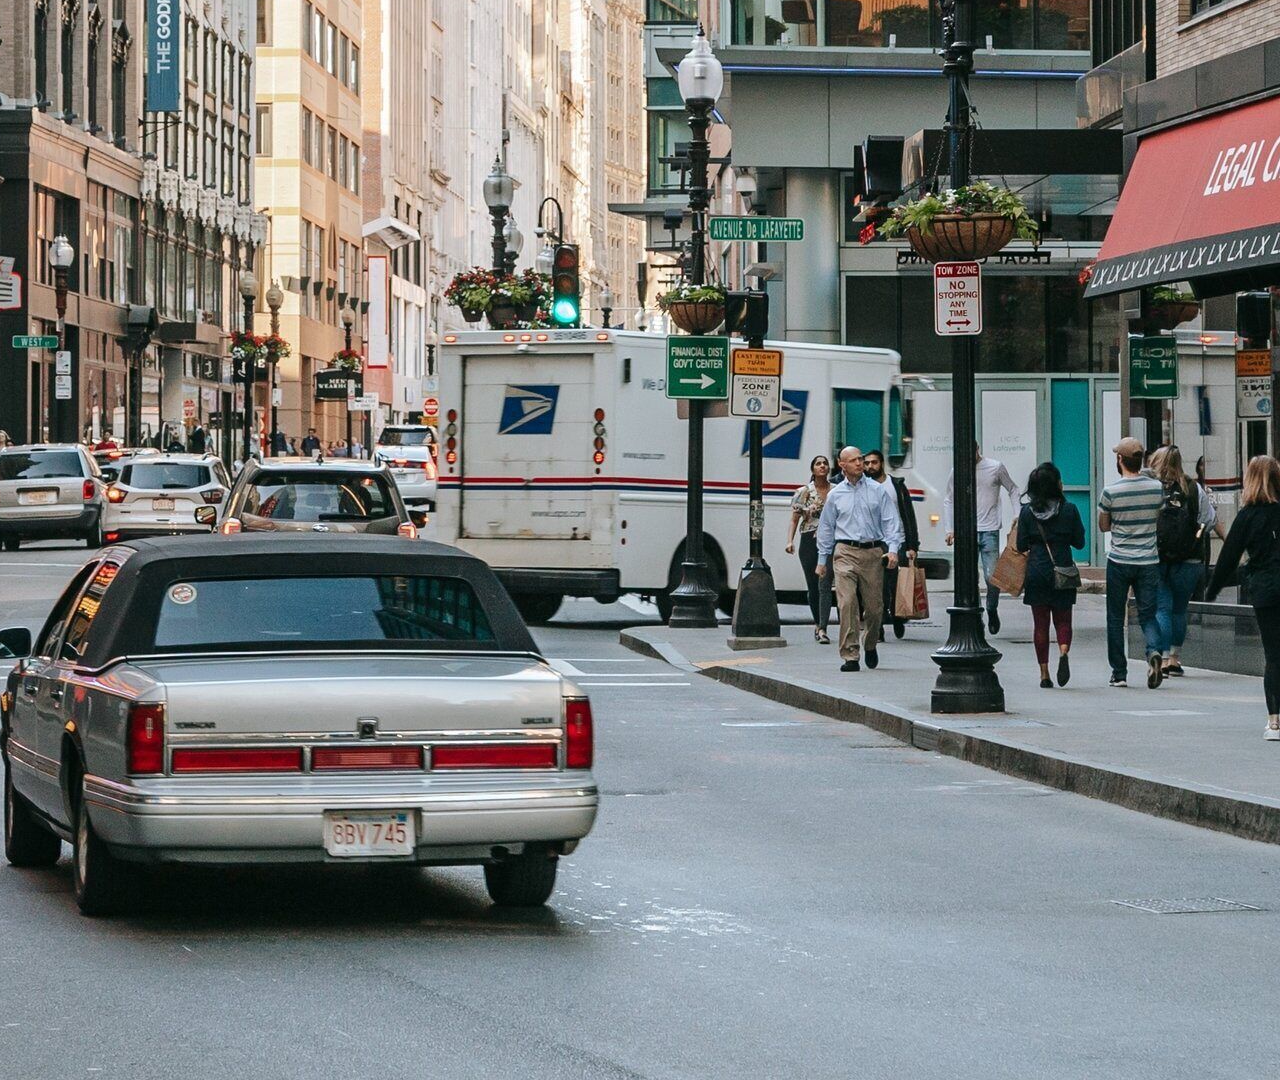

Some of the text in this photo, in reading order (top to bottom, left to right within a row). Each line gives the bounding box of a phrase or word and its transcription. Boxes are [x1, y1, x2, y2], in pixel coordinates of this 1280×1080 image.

[157, 42, 170, 74] THE
[1204, 139, 1265, 196] LEGAL
[713, 219, 802, 239] AVENUE De LAFAYETTE
[1091, 268, 1108, 288] LX
[1107, 264, 1123, 284] LX
[1121, 261, 1139, 280] LX
[1137, 258, 1154, 278] LX
[1154, 254, 1171, 274] LX
[1169, 251, 1188, 271] LX
[1188, 247, 1206, 268] LX
[1207, 243, 1226, 265] LX
[1227, 239, 1247, 261] LX
[1248, 235, 1270, 258] LX
[937, 265, 978, 275] TOW ZONE
[949, 281, 966, 290] NO
[938, 291, 978, 299] STOPPING
[21, 337, 42, 347] WEST
[671, 347, 726, 357] FINANCIAL DIST.
[696, 359, 723, 369] CENTER
[642, 379, 656, 390] We
[372, 823, 406, 844] 745
